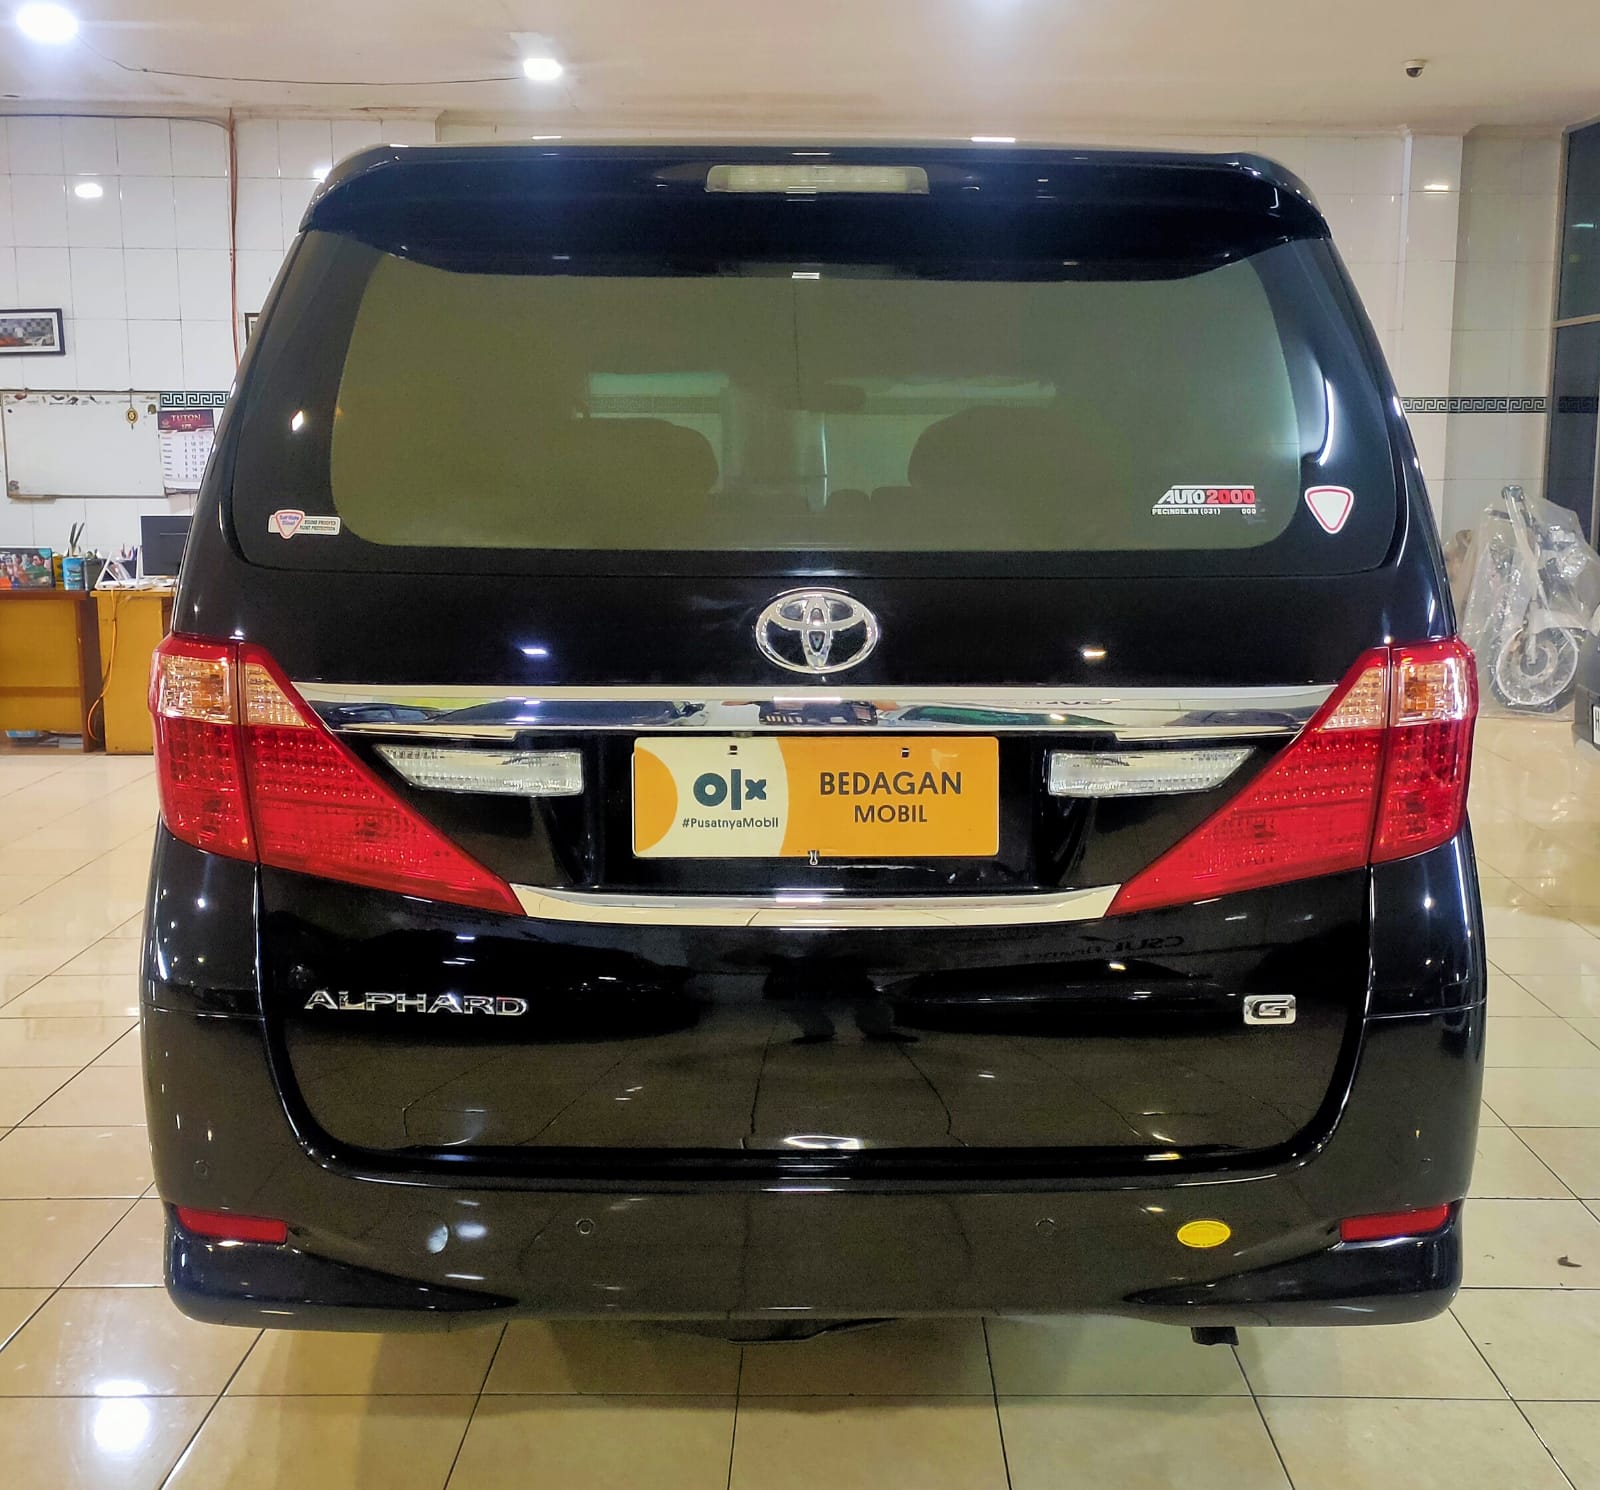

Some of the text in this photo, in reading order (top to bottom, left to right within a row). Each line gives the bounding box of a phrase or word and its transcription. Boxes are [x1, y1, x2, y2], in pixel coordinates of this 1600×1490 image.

[1157, 489, 1256, 504] AUTO2000
[693, 768, 767, 811] olx
[819, 771, 962, 796] BEDAGAN
[682, 816, 779, 830] #PusatnyaMobil
[853, 804, 928, 824] MOBIL
[304, 990, 527, 1016] ALPHARD
